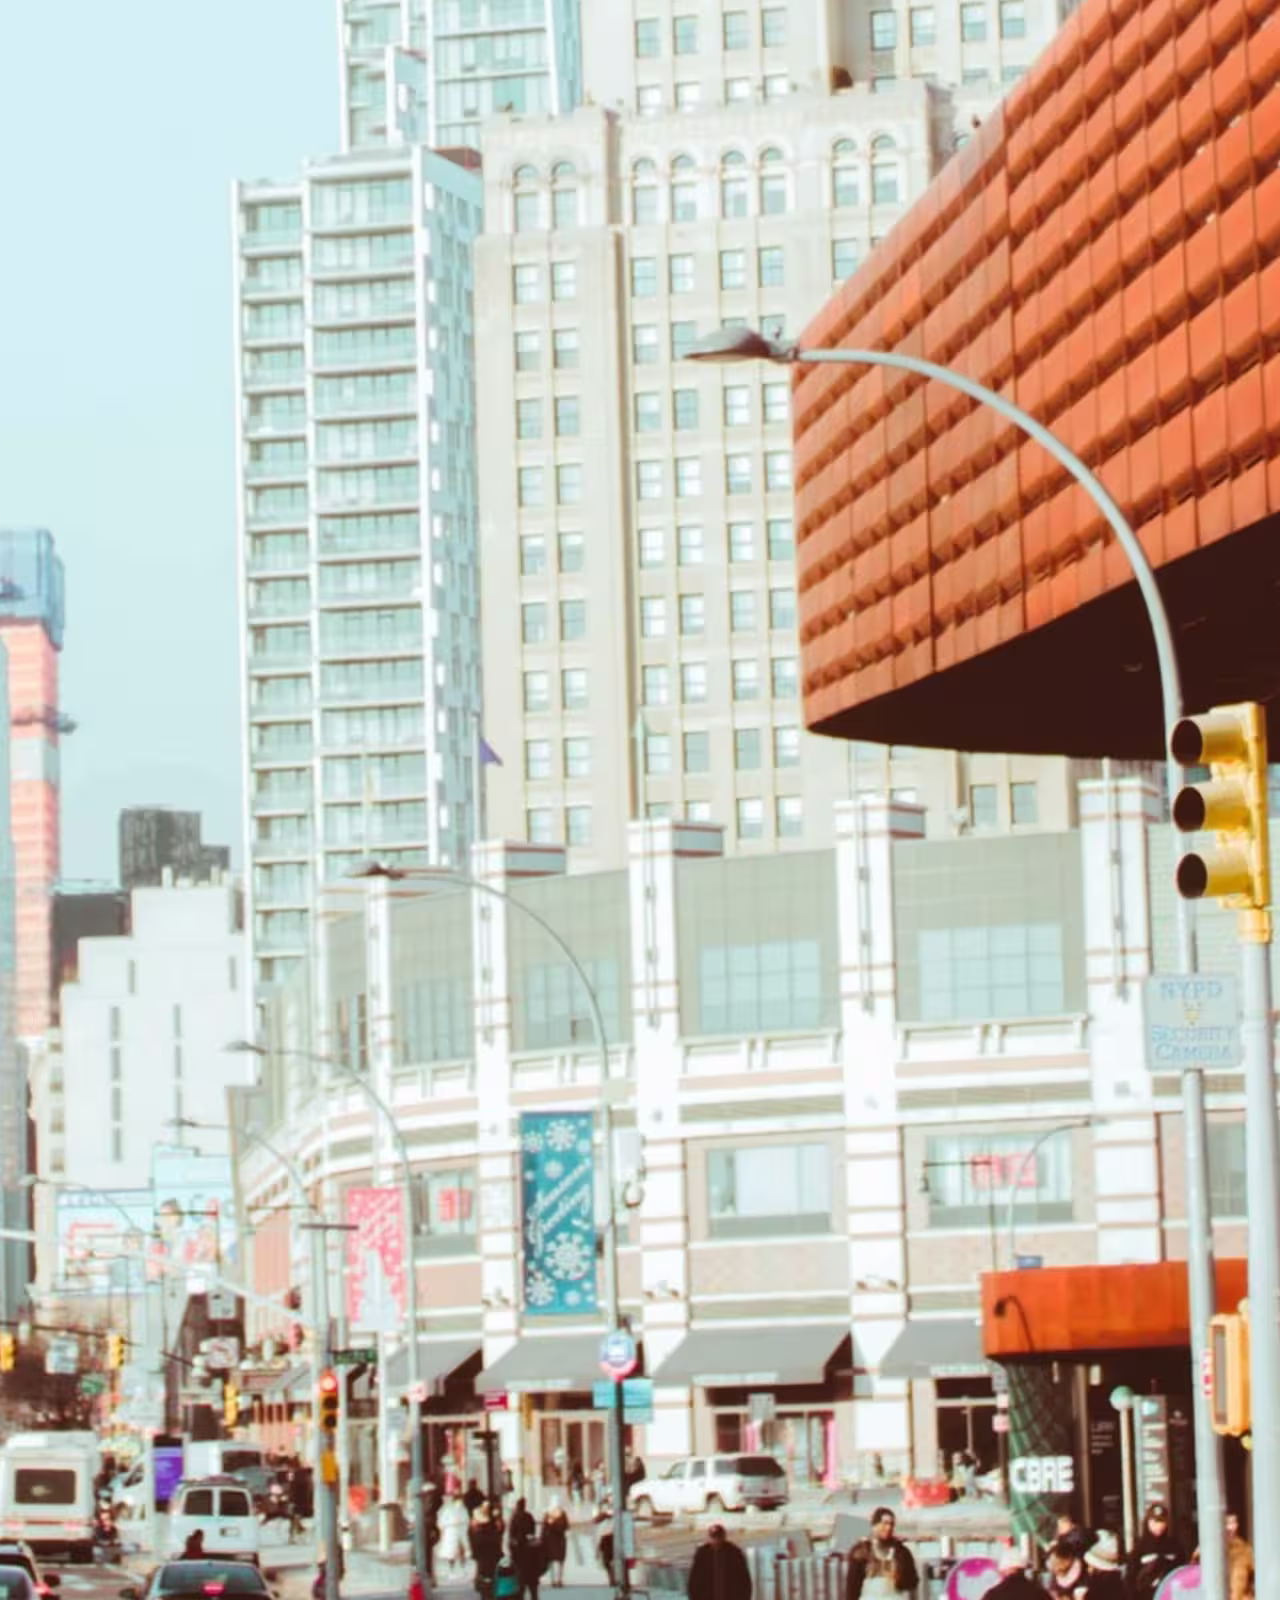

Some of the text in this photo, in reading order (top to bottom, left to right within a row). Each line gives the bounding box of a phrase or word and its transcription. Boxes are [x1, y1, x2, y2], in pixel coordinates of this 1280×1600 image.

[1159, 980, 1223, 1000] NYPD
[1151, 1024, 1235, 1042] SECURITY
[1154, 1042, 1234, 1060] CAMERA
[1009, 1455, 1074, 1493] CBRE
